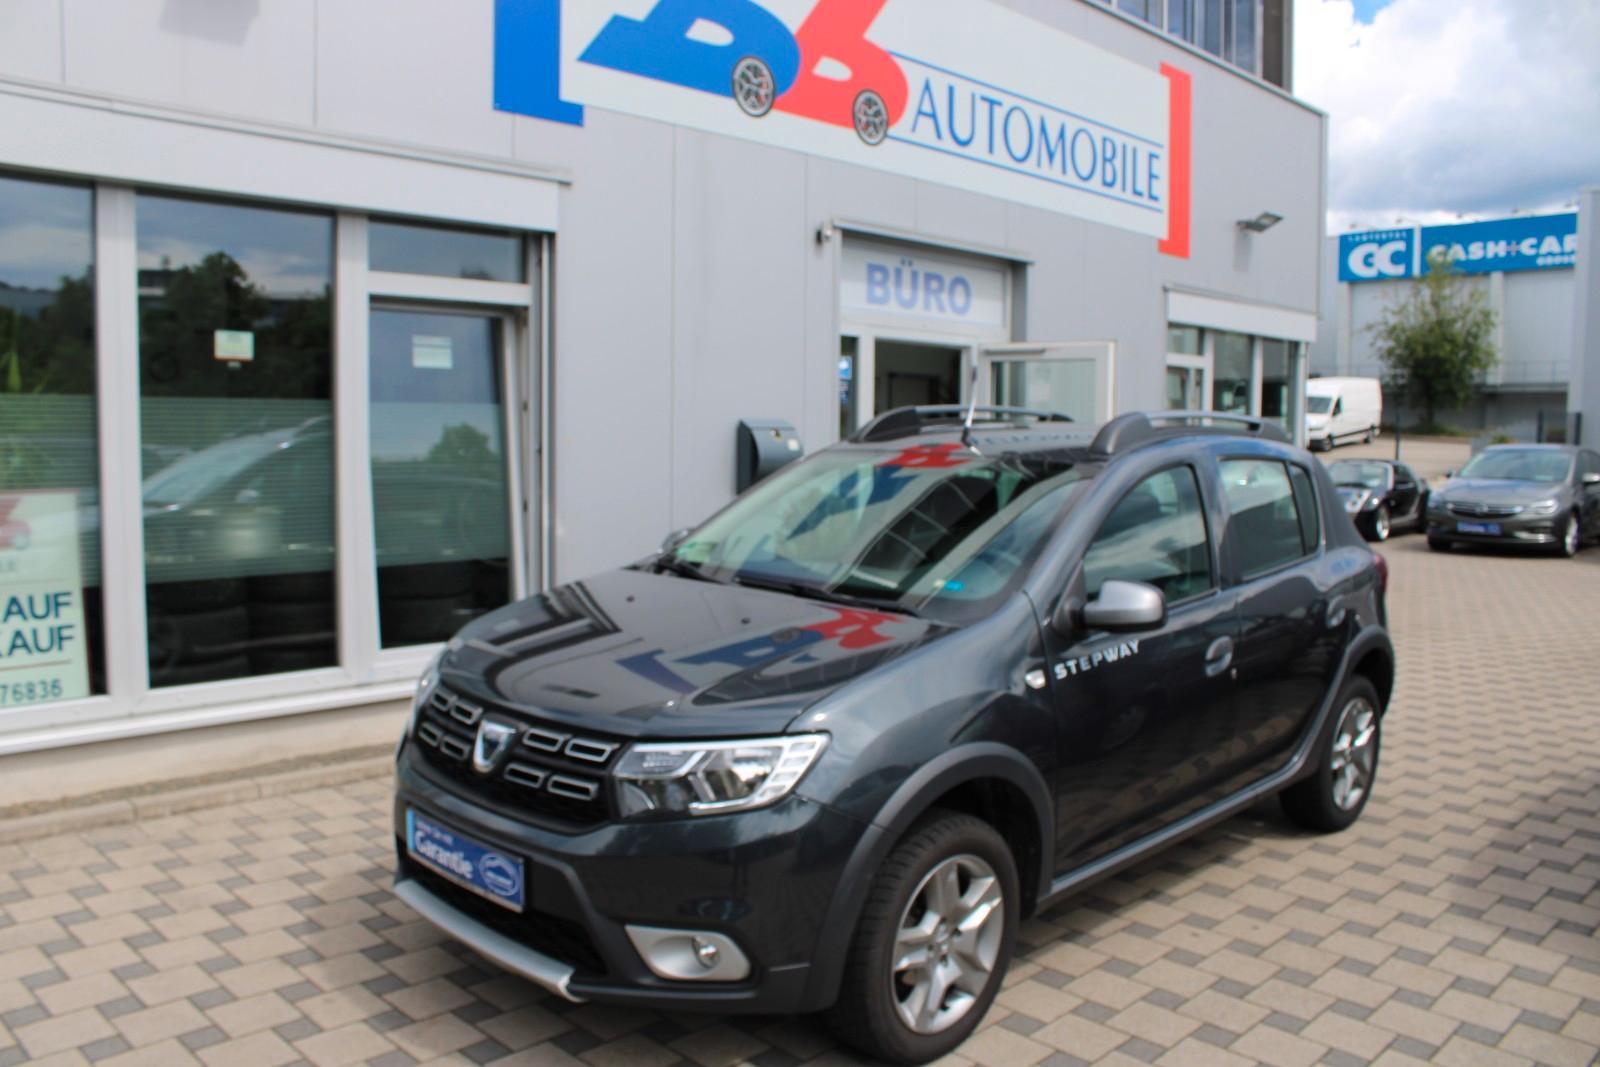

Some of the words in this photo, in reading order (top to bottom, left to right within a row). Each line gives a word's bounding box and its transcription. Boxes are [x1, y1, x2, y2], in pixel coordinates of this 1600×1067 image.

[911, 76, 1161, 203] AUTOMOBILE
[865, 258, 972, 316] BÜRO
[2, 591, 73, 623] AUF
[0, 624, 75, 657] AUF
[1054, 639, 1139, 680] STEPWAY
[414, 829, 474, 880] Garantie
